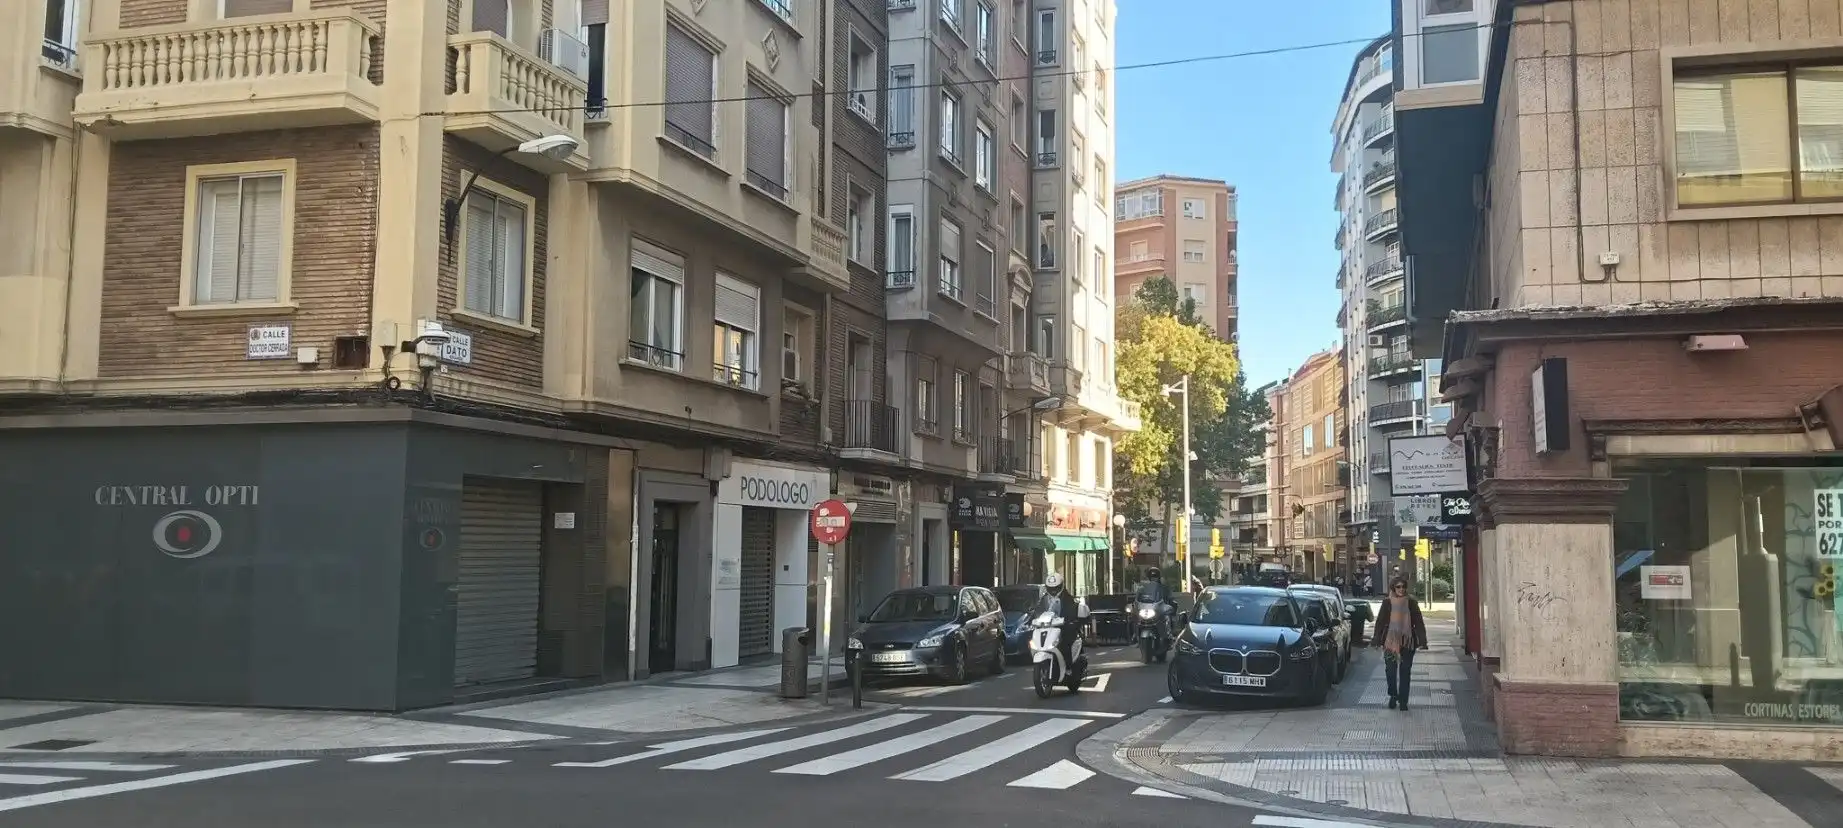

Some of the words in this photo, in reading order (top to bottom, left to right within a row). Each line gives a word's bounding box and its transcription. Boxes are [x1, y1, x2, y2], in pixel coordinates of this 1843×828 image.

[263, 330, 285, 338] CALLE
[452, 335, 469, 346] CALLE
[446, 345, 467, 357] DATO
[95, 485, 192, 506] CENTRAL
[205, 485, 259, 506] OPTI
[741, 476, 809, 505] PODOLOGO
[1817, 493, 1833, 517] SE
[1818, 520, 1842, 529] POR
